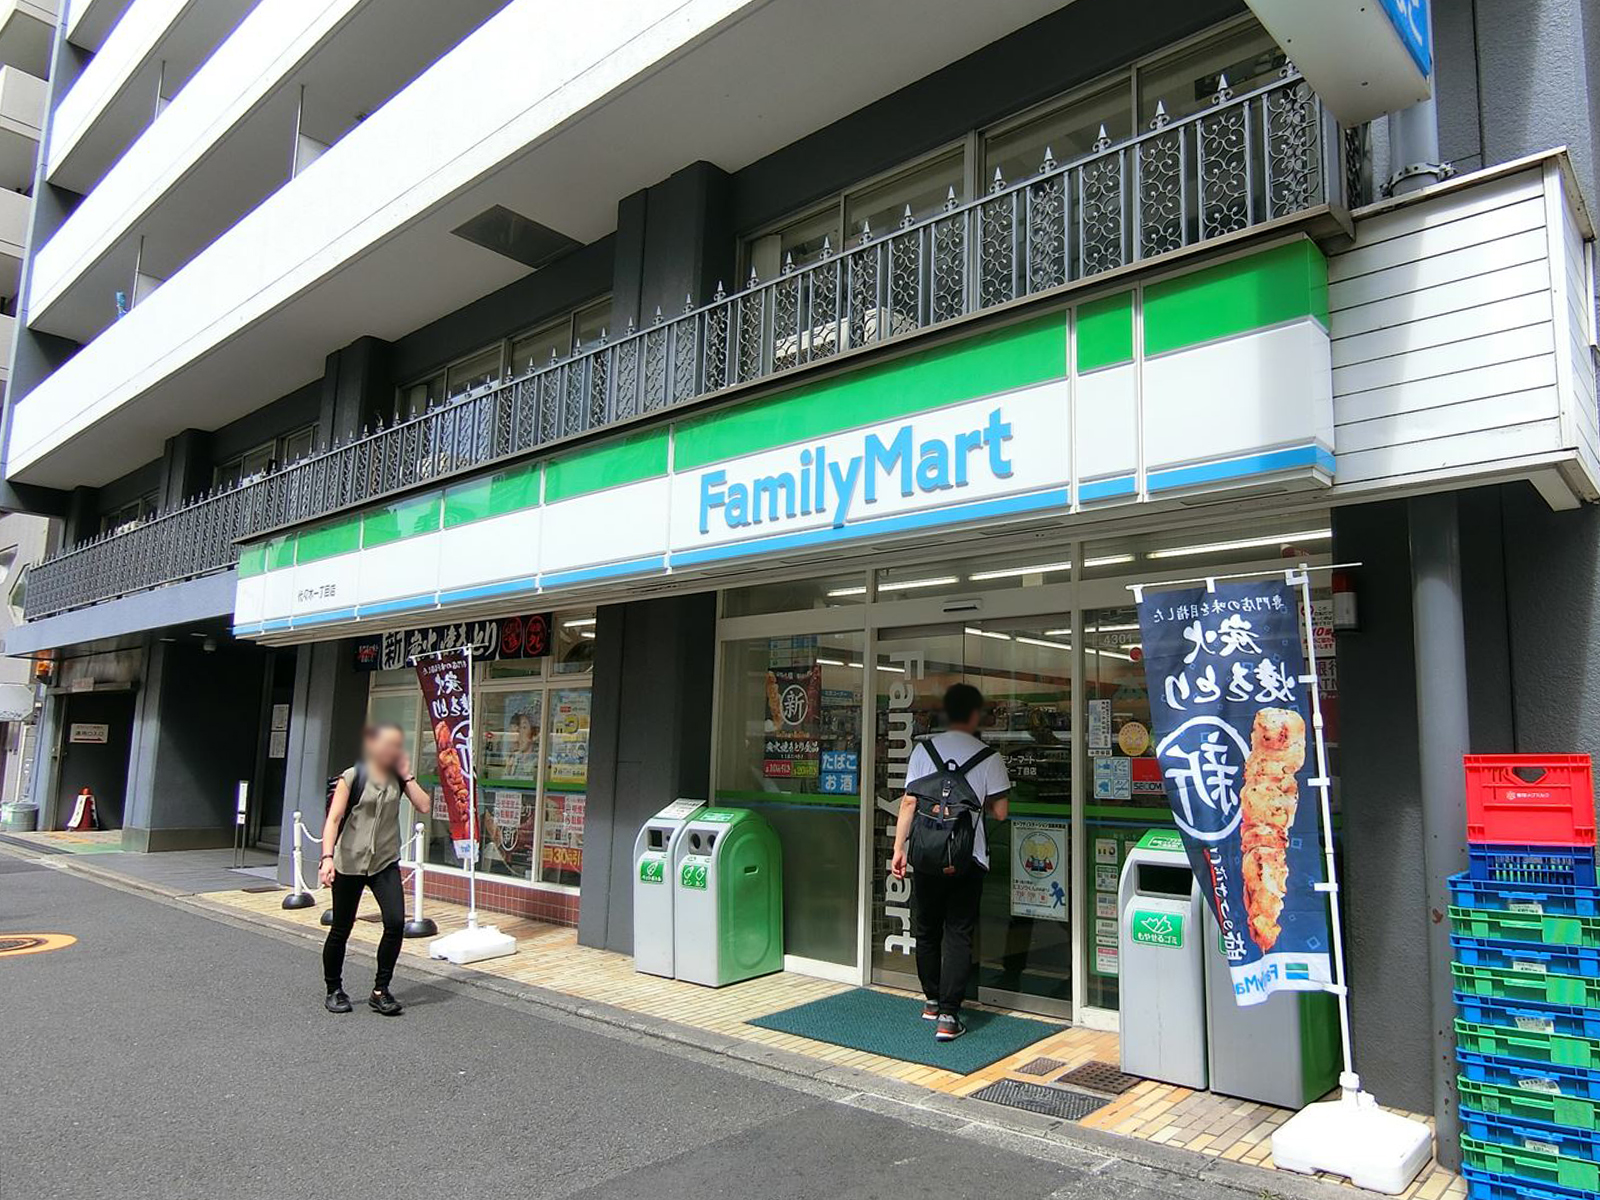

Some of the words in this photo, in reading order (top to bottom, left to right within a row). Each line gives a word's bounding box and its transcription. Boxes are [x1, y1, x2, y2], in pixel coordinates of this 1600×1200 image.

[700, 408, 1015, 532] FamilyMart
[298, 584, 336, 602] 代々木一丁目店
[784, 690, 805, 721] 新
[822, 754, 857, 770] たばこ
[825, 774, 853, 791] お酒
[1133, 782, 1162, 791] SECOM
